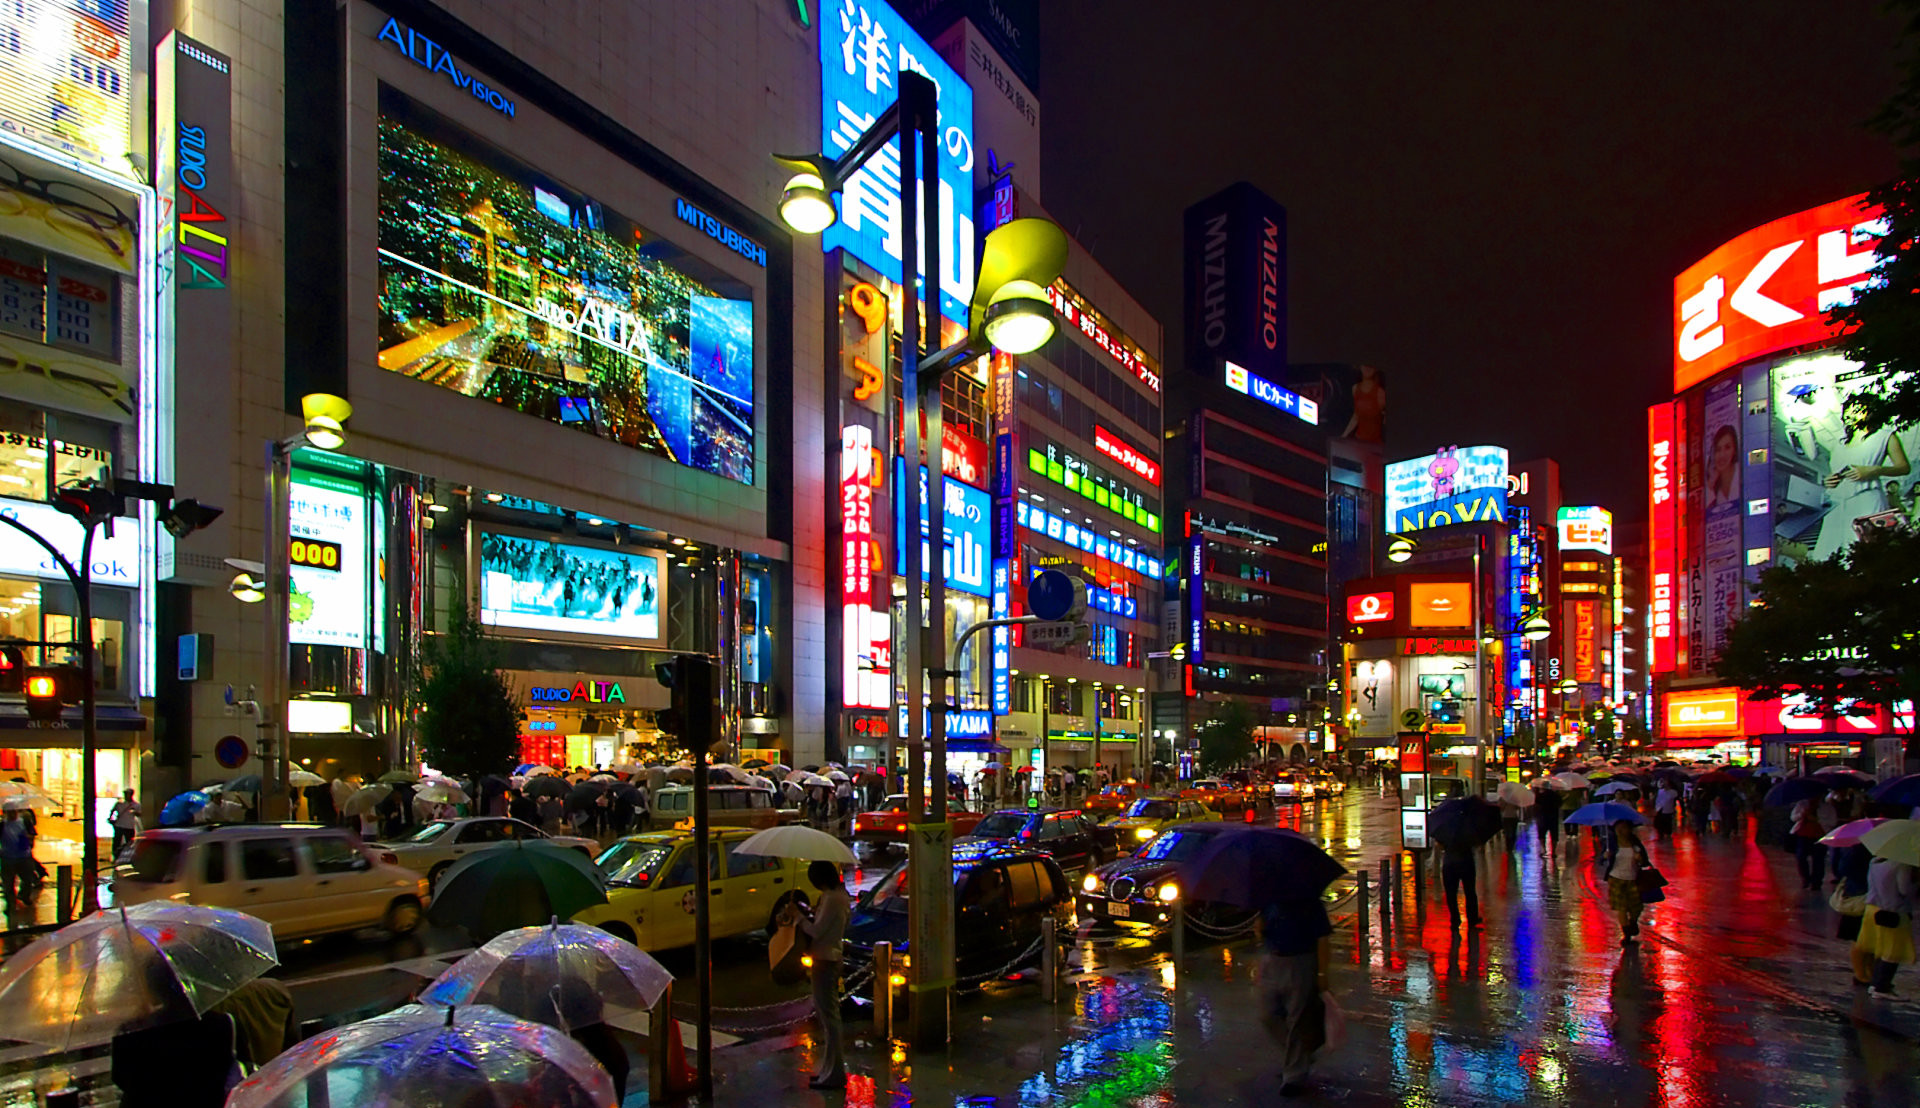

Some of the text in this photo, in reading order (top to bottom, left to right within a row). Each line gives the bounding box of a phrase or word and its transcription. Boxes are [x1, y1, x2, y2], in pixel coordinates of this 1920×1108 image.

[987, 0, 1021, 48] SMBC
[838, 0, 974, 173] 洋の
[970, 40, 1037, 127] 三井住友銀行
[179, 121, 228, 290] STUDIO ALTA
[676, 197, 767, 267] MITSUBISHI
[1204, 213, 1227, 347] MIZUHO
[1263, 217, 1279, 349] MIZUHO
[534, 299, 650, 360] STUDIO ALTA
[1254, 378, 1294, 409] UCカード
[1653, 440, 1670, 504] さくらや
[845, 485, 857, 533] アコム
[859, 485, 870, 533] アコム
[1402, 496, 1503, 532] NOVA
[40, 553, 128, 578] aook
[1167, 608, 1177, 681] 三井住行
[531, 680, 626, 703] STUDIO ALTA
[1405, 712, 1419, 727] 2
